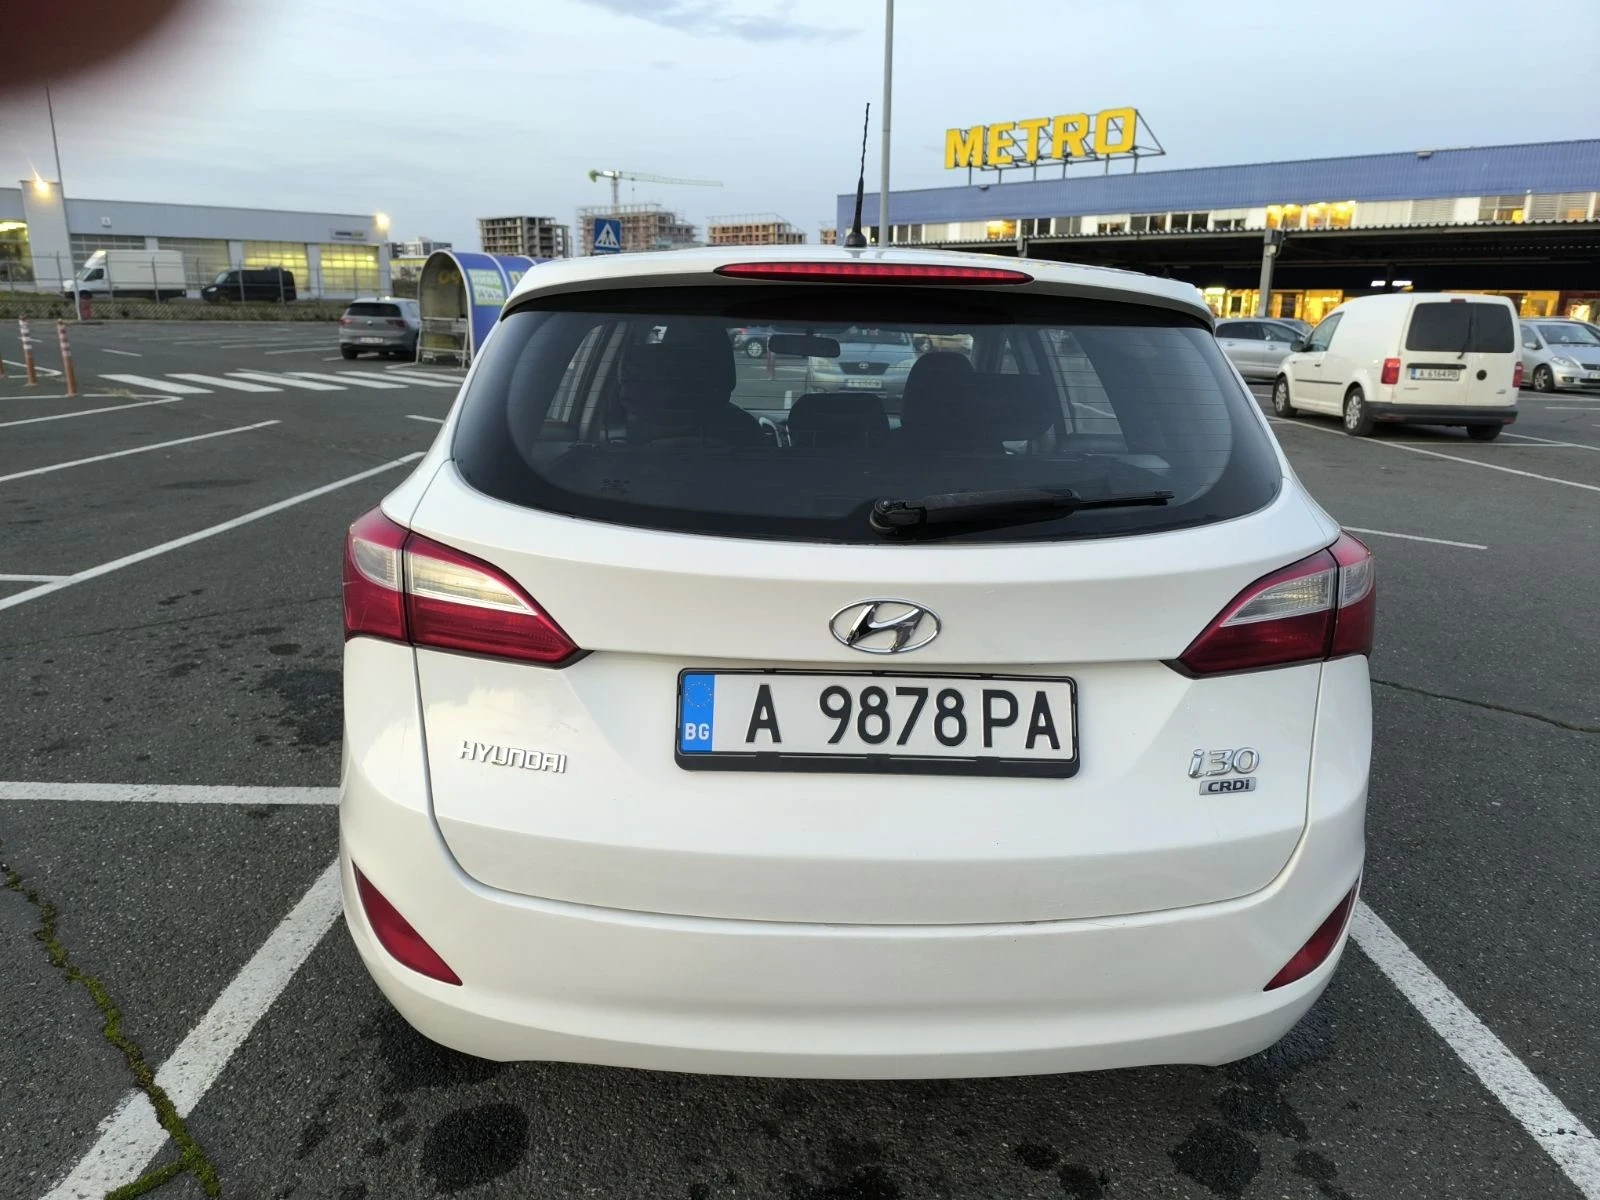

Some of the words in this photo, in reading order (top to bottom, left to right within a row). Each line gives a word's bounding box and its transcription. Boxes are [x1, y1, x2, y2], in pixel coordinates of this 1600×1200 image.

[945, 107, 1137, 169] METRO
[745, 684, 782, 742] A
[685, 723, 710, 740] BG
[460, 739, 567, 774] HYUNDAI
[1188, 747, 1259, 779] i30
[1207, 779, 1250, 792] CRDi
